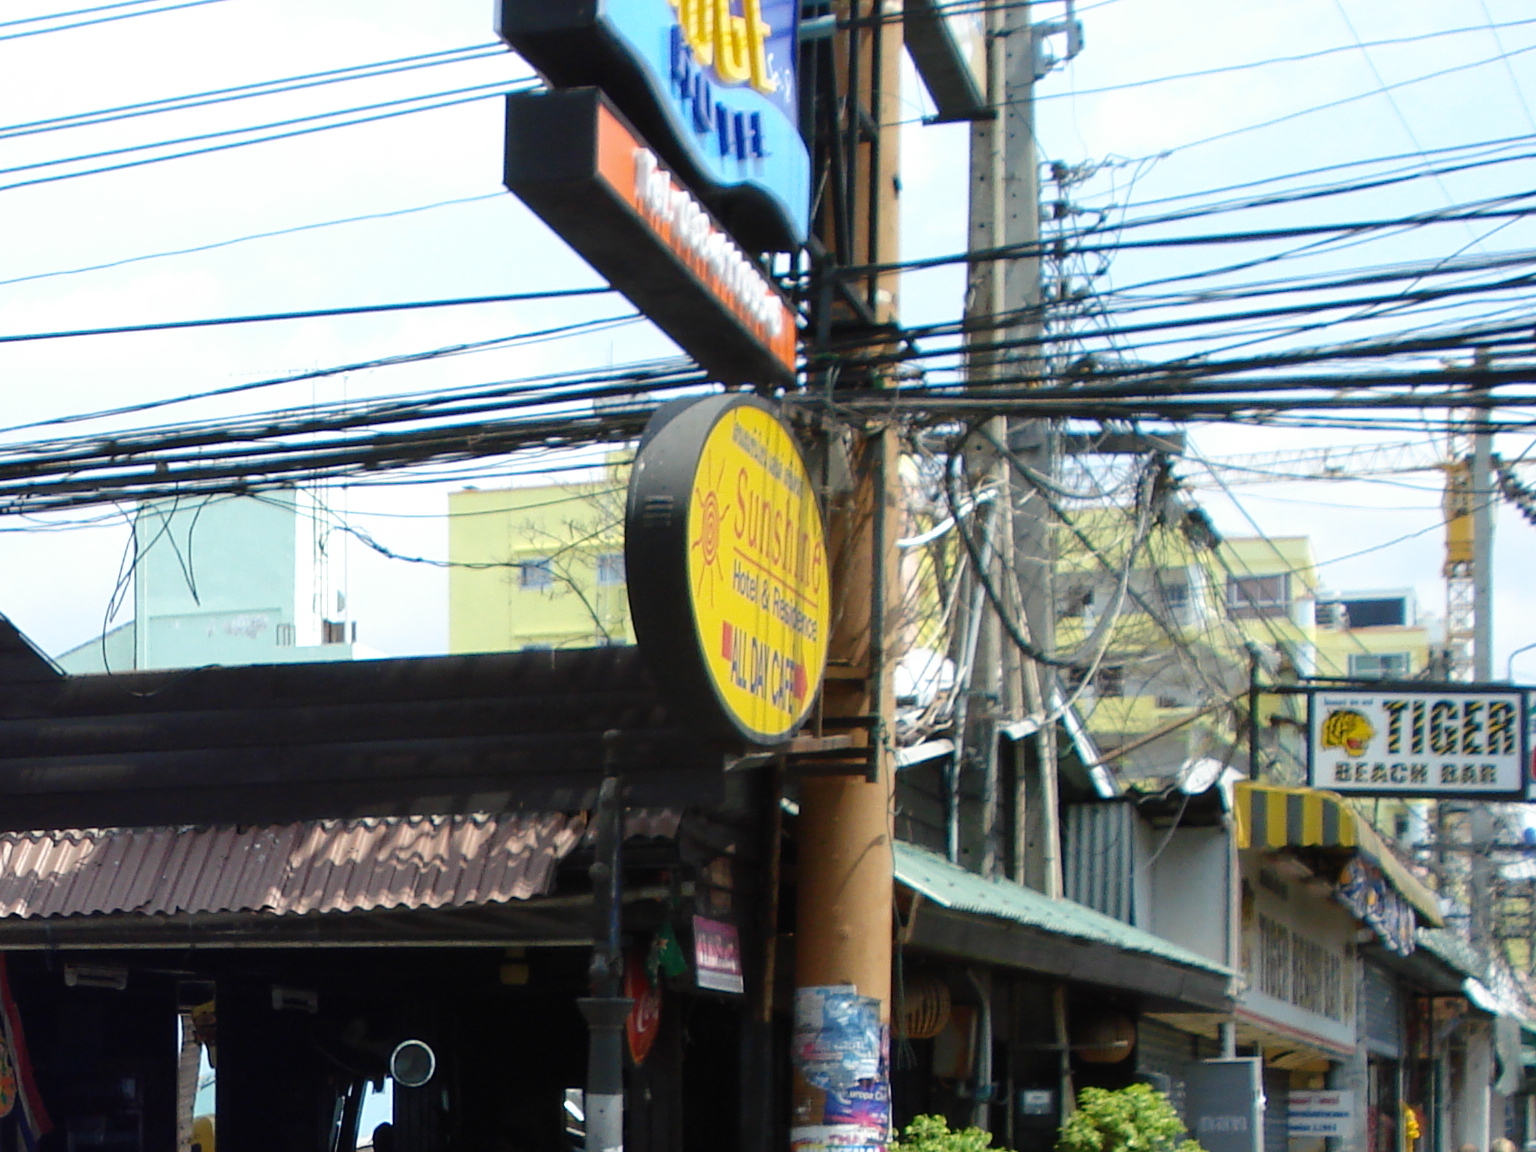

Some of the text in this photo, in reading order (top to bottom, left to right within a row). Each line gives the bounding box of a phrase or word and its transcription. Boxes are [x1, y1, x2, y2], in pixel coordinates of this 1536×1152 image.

[734, 467, 822, 595] Sunshine
[733, 558, 759, 604] Hotel
[773, 586, 818, 643] Residence
[731, 625, 748, 689] ALL
[750, 636, 771, 700] DAY
[1382, 699, 1517, 755] TIGER
[1334, 761, 1498, 785] BEACH BAR
